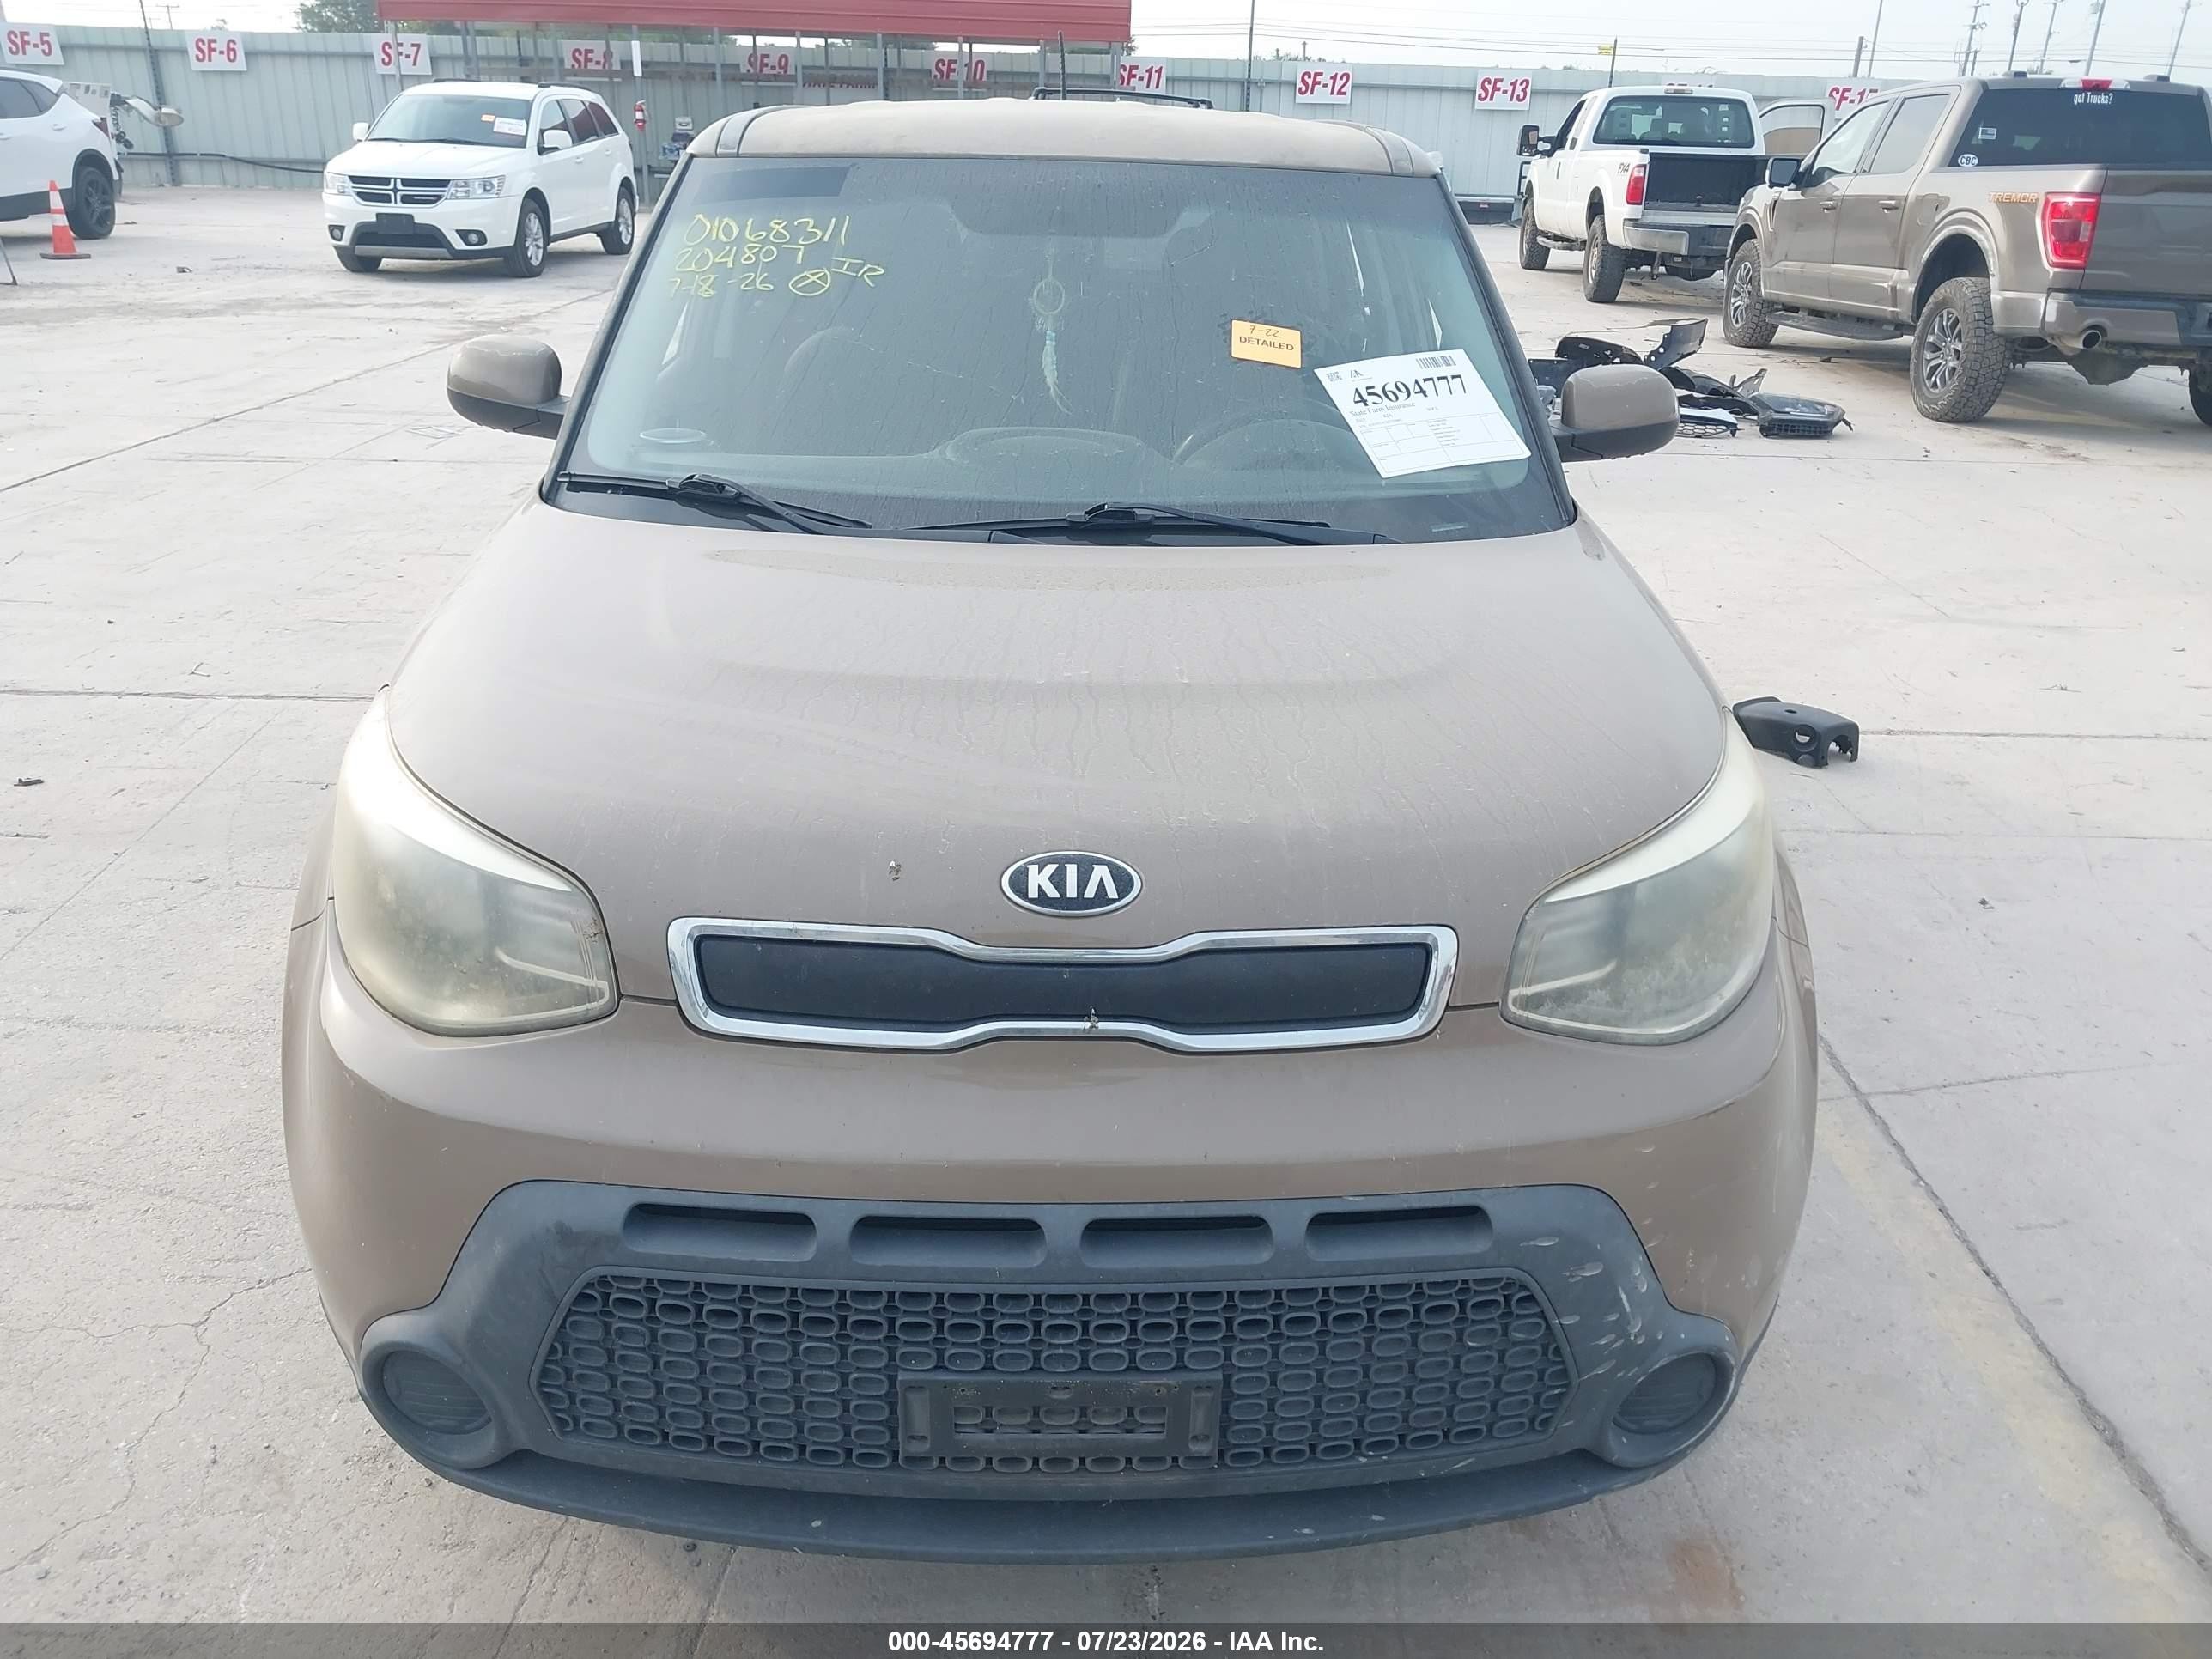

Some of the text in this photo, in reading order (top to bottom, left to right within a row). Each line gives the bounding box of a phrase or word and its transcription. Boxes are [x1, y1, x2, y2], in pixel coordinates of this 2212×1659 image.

[6, 29, 52, 57] SF-5
[195, 37, 237, 64] SF-6
[380, 41, 422, 67] SF-7
[746, 52, 789, 75] SF-9
[933, 58, 986, 81] SF10
[1119, 64, 1164, 89] SF-11
[1297, 70, 1351, 96] SF-12
[1477, 76, 1530, 103] SF-13
[2073, 92, 2113, 105] got Trucks?
[1959, 155, 1978, 166] CBC
[1989, 191, 2039, 204] TREMOR
[684, 214, 850, 246] 01068311
[675, 244, 805, 273] 204807
[1239, 336, 1295, 351] DETAILED
[1352, 374, 1467, 407] 45694777
[1026, 863, 1119, 900] KIA
